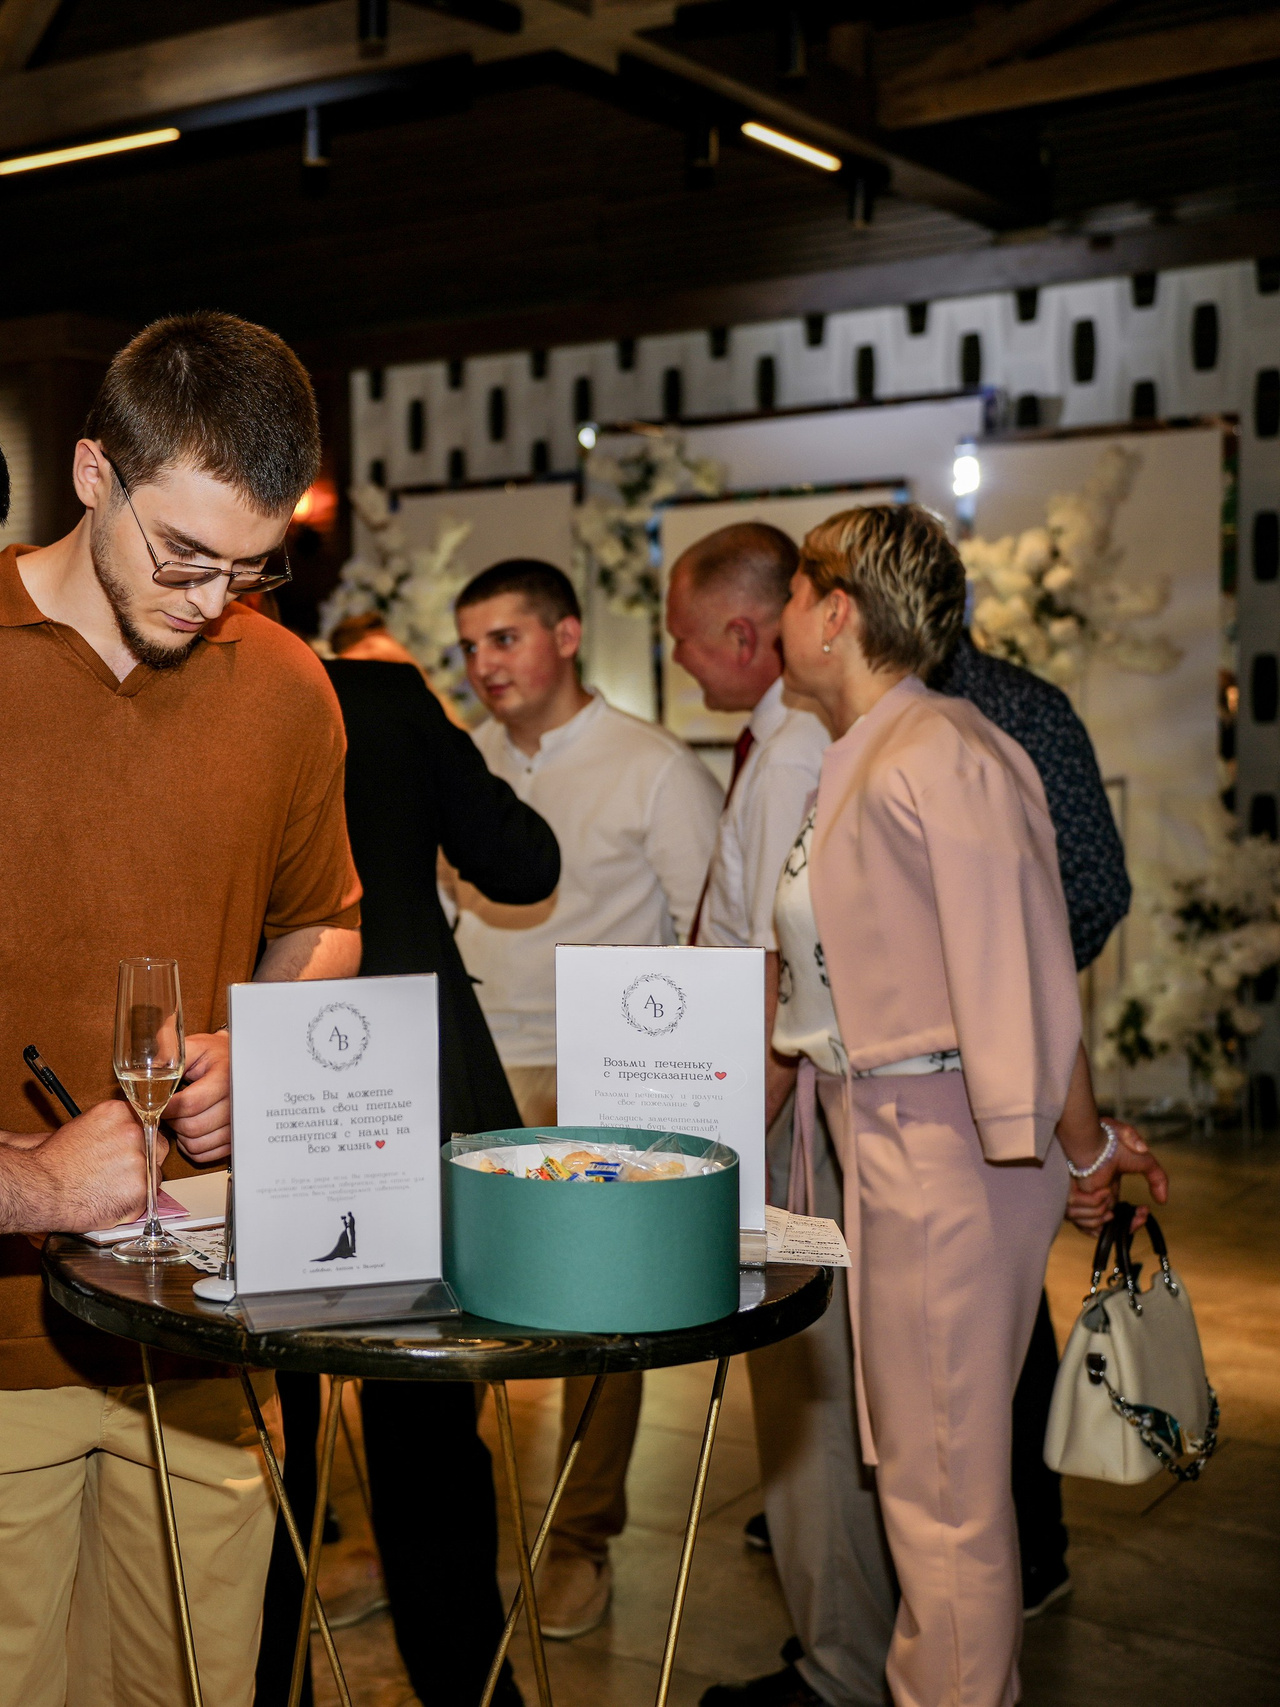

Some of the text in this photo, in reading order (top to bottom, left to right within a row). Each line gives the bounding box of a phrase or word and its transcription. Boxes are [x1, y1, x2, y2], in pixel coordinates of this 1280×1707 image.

[603, 1057, 713, 1071] Возьми печеньку
[603, 1070, 713, 1081] с предсказанием
[283, 1088, 394, 1105] Здесь Вы можете
[594, 1089, 630, 1099] Разломи
[634, 1091, 675, 1101] печеньку
[691, 1094, 724, 1102] получи
[265, 1100, 413, 1117] написать свои теплые
[617, 1099, 689, 1108] свое пожелание
[275, 1113, 404, 1129] пожелания, которые
[599, 1113, 720, 1125] Насладись замечательным
[267, 1126, 411, 1143] останутся с нами на
[671, 1123, 719, 1133] счастлив!
[307, 1142, 372, 1154] всю жизнь
